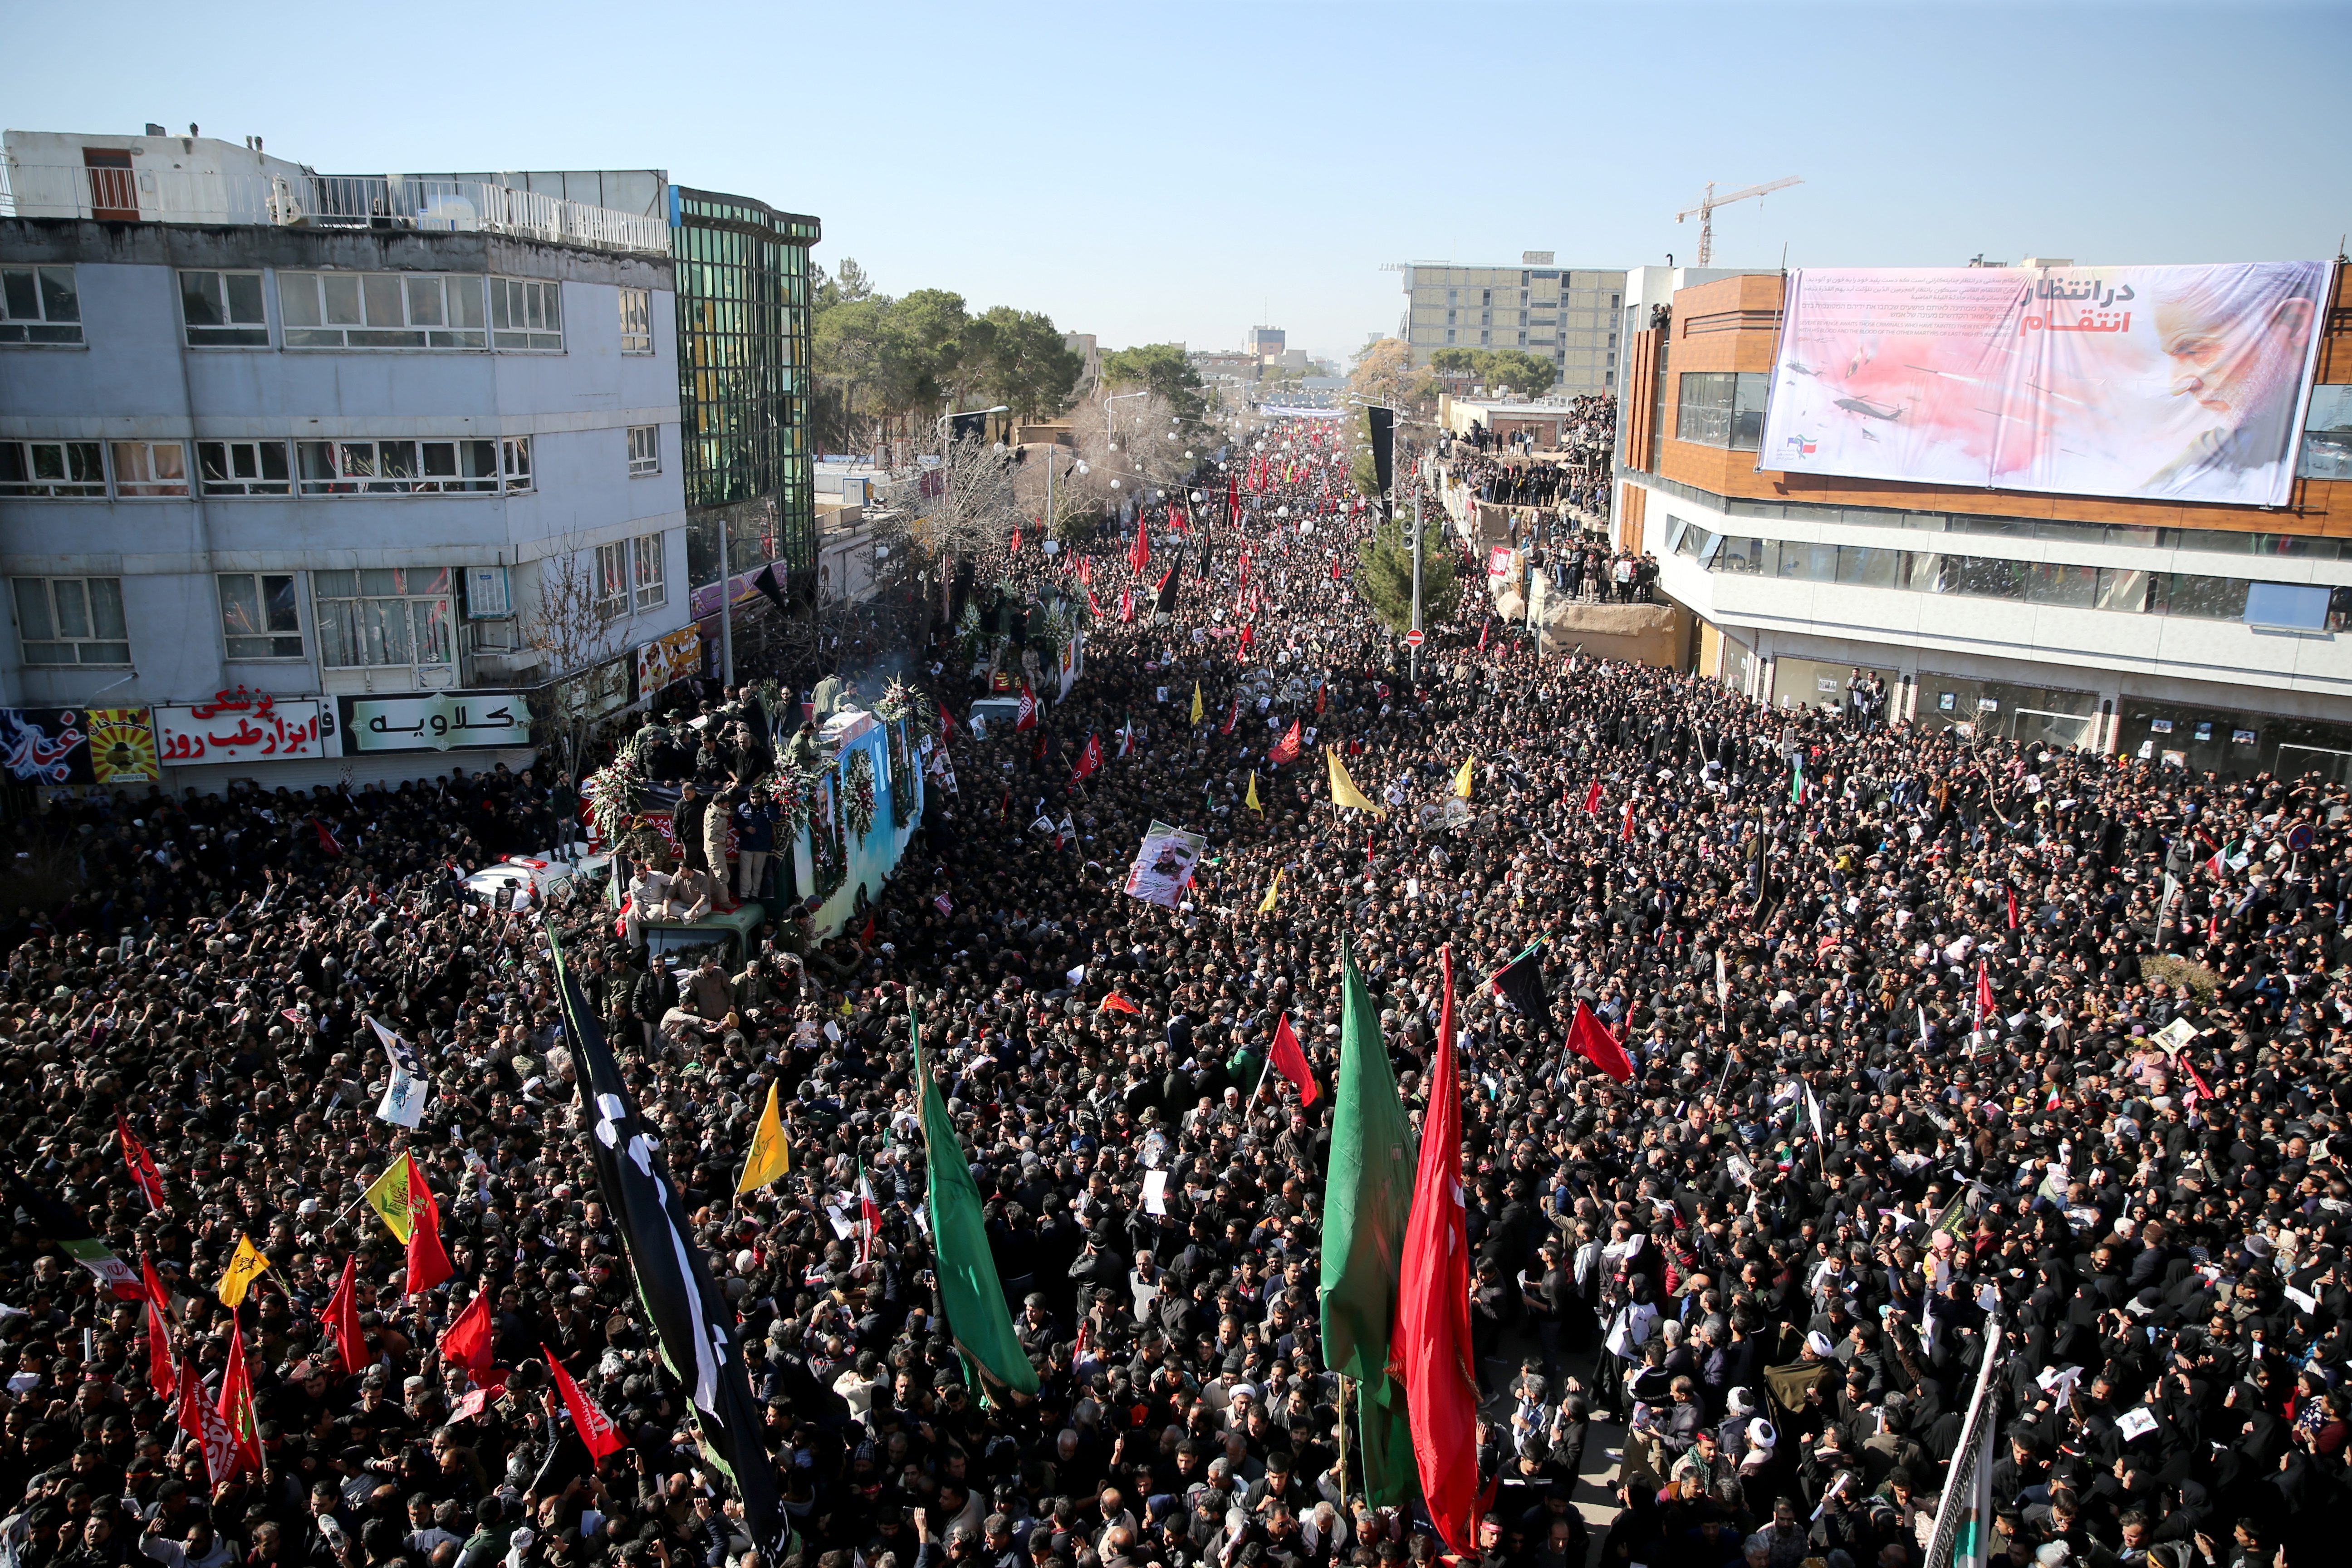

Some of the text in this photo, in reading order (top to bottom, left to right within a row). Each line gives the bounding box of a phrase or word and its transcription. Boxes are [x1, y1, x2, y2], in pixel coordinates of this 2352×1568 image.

[2019, 309, 2132, 337] انتقام
[191, 684, 276, 723] پزشکی
[208, 718, 263, 756] طب
[260, 715, 317, 755] ابزار
[369, 706, 515, 737] کلاویه
[161, 728, 205, 760] روز
